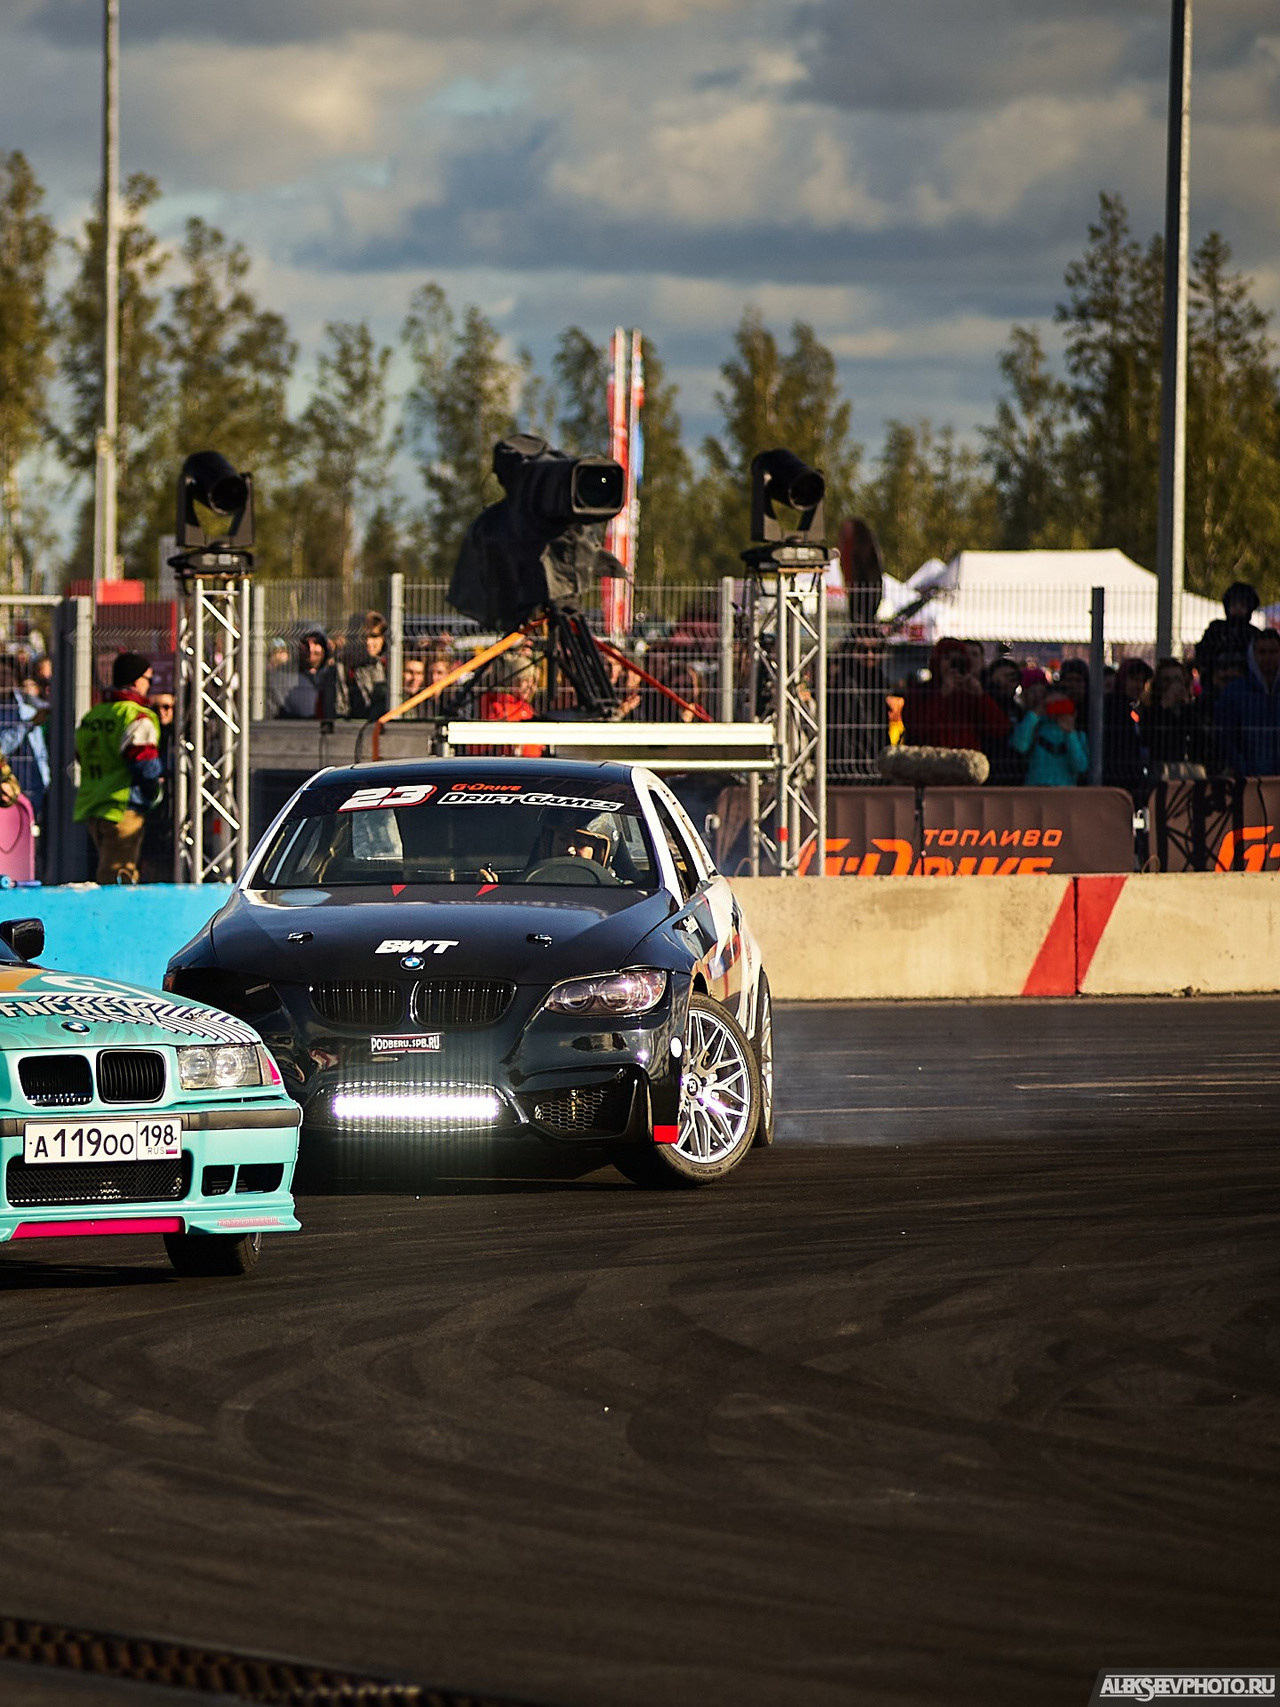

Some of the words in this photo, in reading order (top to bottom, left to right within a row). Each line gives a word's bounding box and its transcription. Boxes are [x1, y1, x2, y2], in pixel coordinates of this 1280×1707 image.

[338, 785, 437, 812] 23
[437, 793, 521, 806] DRIFT
[519, 793, 625, 812] GAMES
[923, 828, 1063, 848] ТОПЛИВО
[374, 939, 460, 954] BWT
[139, 1124, 174, 1147] 198
[147, 1146, 166, 1155] RUS
